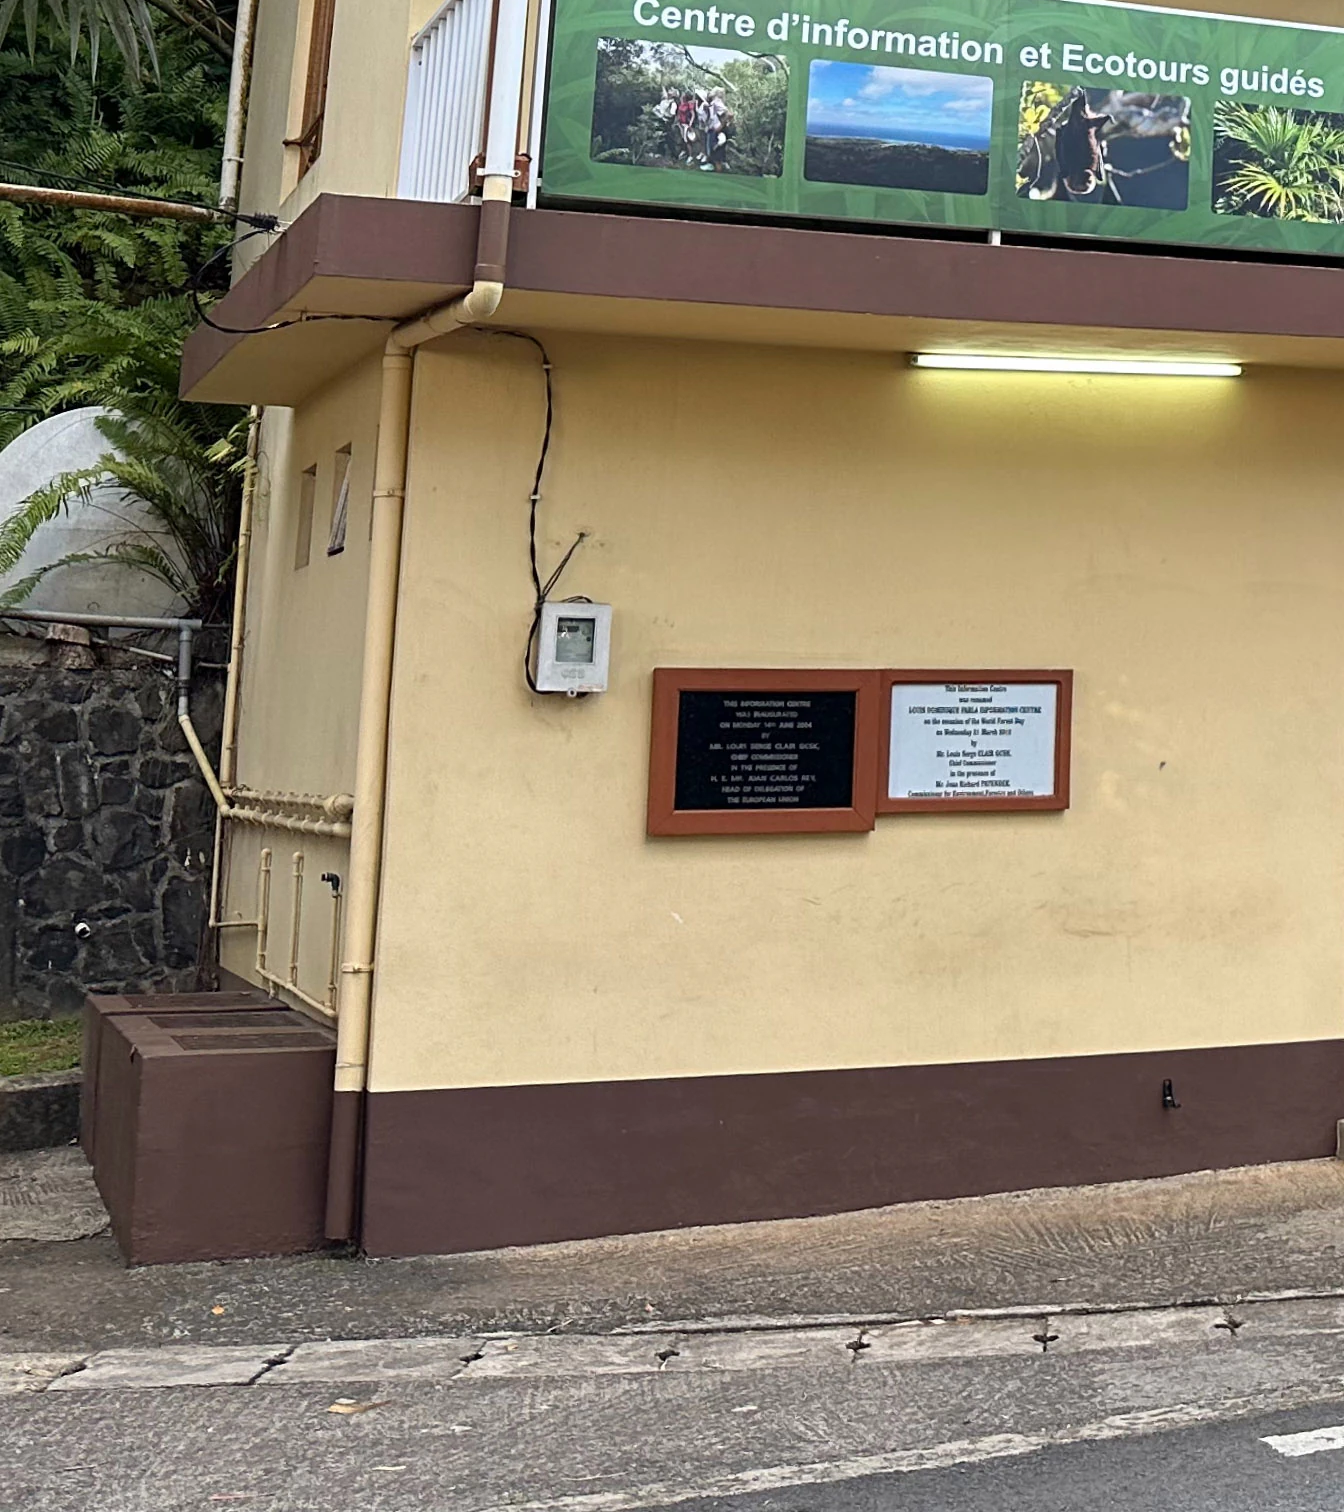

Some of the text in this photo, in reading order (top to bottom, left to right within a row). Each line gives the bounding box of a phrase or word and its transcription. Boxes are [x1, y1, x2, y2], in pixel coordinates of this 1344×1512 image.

[767, 12, 1003, 65] d’information
[1020, 43, 1051, 69] et
[1062, 43, 1209, 86] Ecotours
[1220, 66, 1325, 97] guidés
